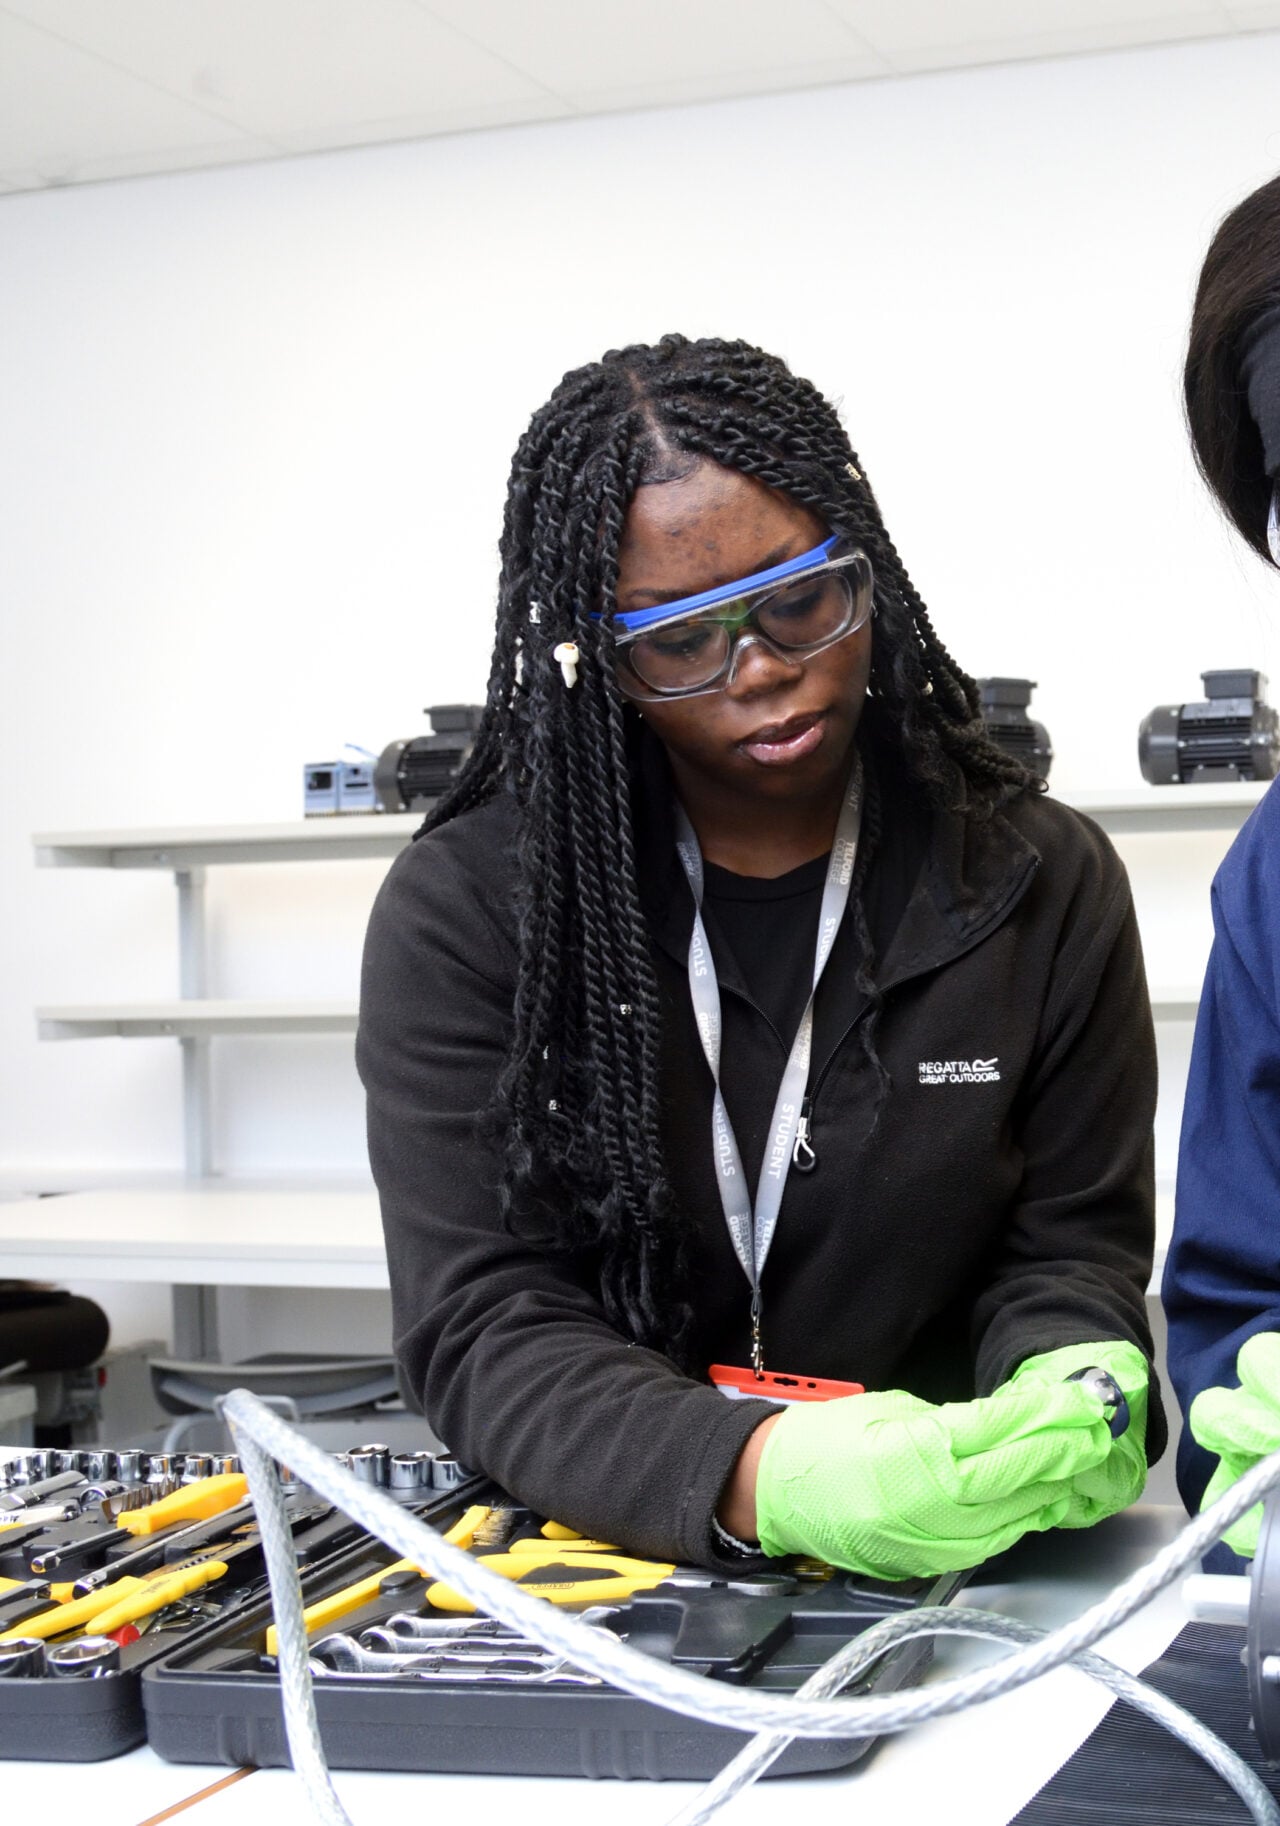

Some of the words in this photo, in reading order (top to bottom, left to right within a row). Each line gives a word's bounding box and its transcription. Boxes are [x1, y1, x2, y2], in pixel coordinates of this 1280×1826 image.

[839, 841, 856, 886] TELFORD
[918, 1060, 972, 1074] REGATTA
[918, 1073, 948, 1084] GREAT
[949, 1071, 1001, 1083] OUTDOORS
[714, 1103, 736, 1177] STUDENT
[768, 1103, 796, 1180] STUDENT
[729, 1215, 748, 1268] TELFORD
